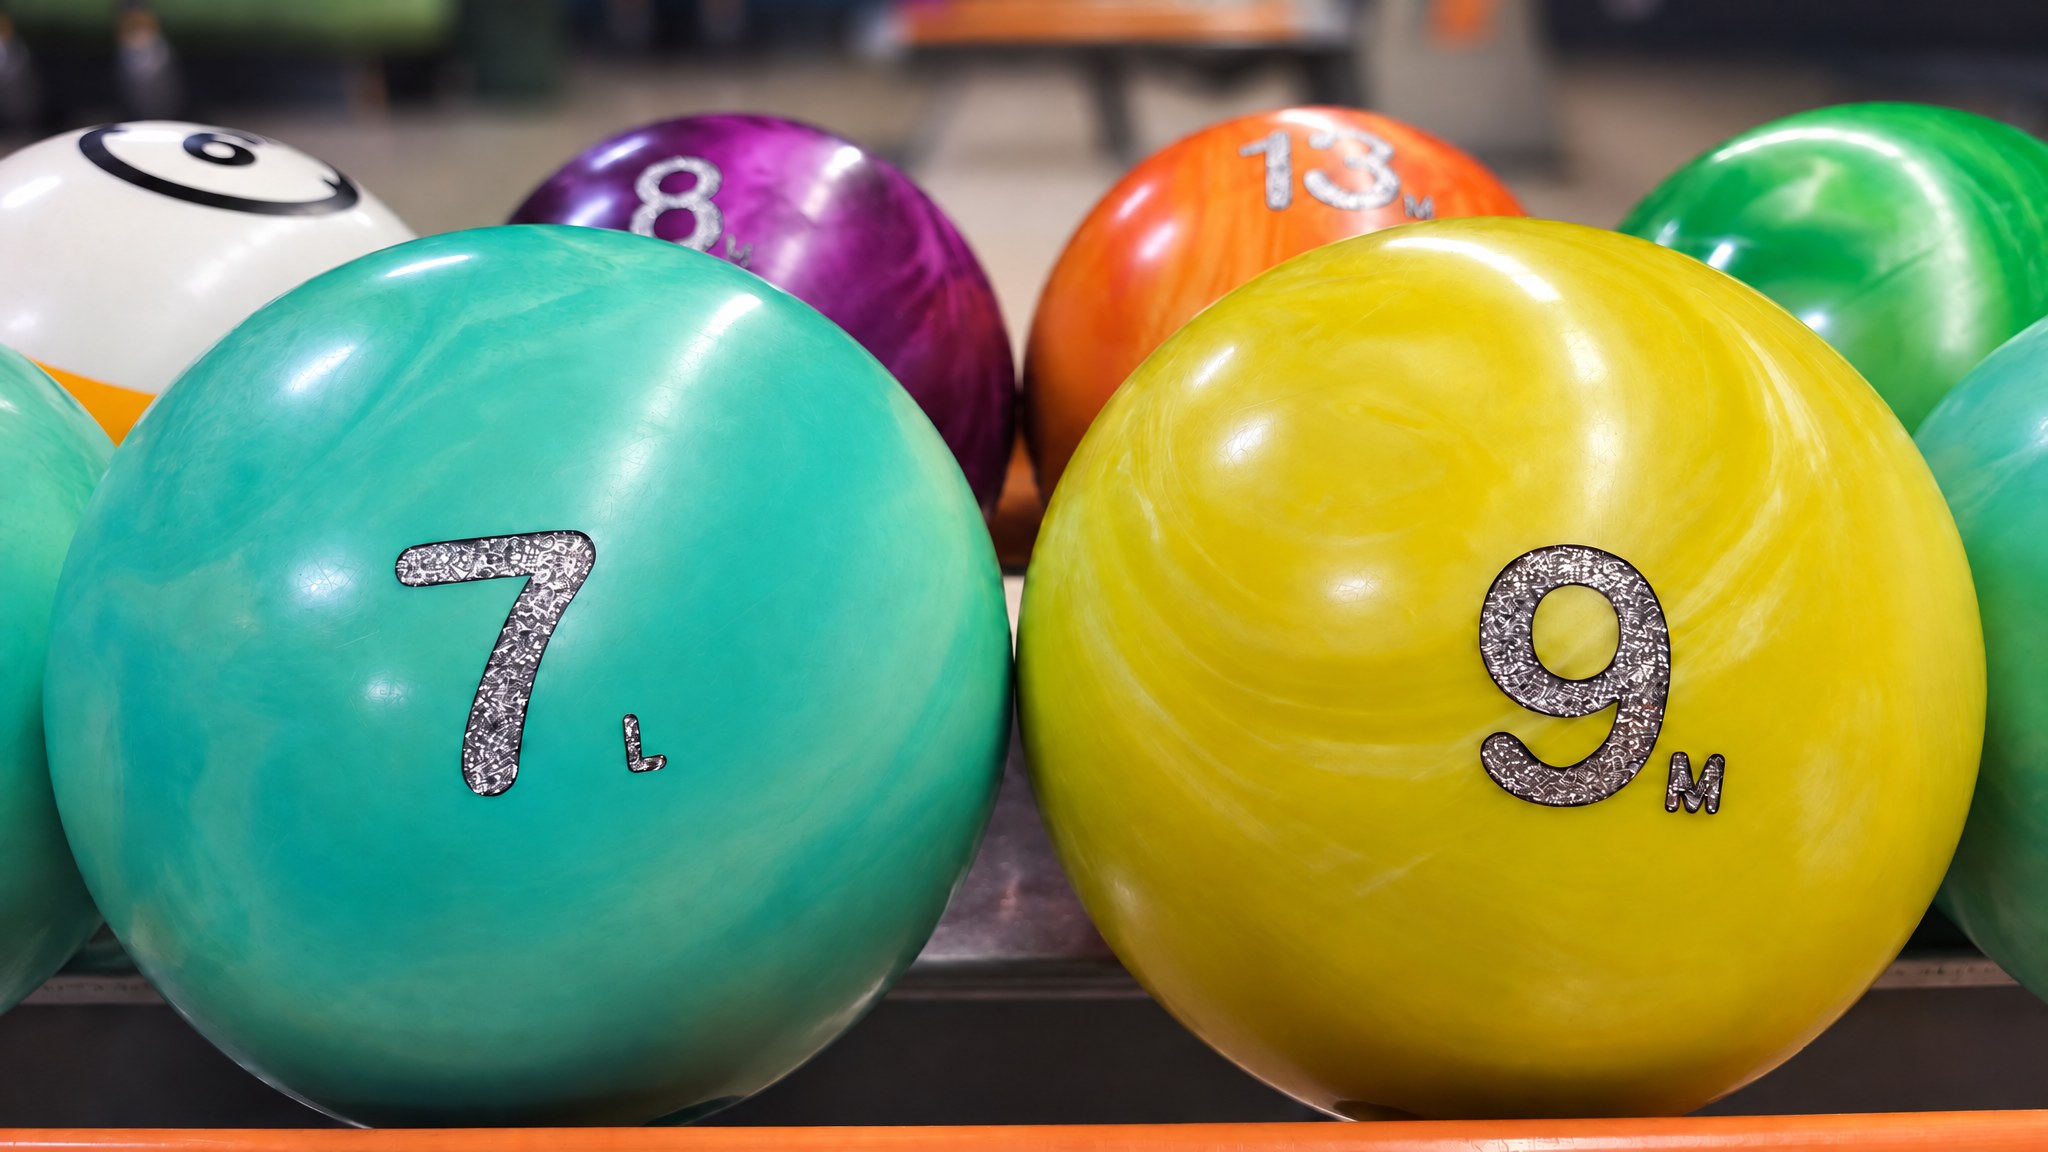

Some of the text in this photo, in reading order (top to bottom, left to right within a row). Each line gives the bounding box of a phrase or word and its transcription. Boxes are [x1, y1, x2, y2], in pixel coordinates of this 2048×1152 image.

[629, 155, 723, 252] 8
[1239, 129, 1400, 210] 13
[395, 530, 667, 796] 7 L
[1480, 544, 1725, 814] 9 M
